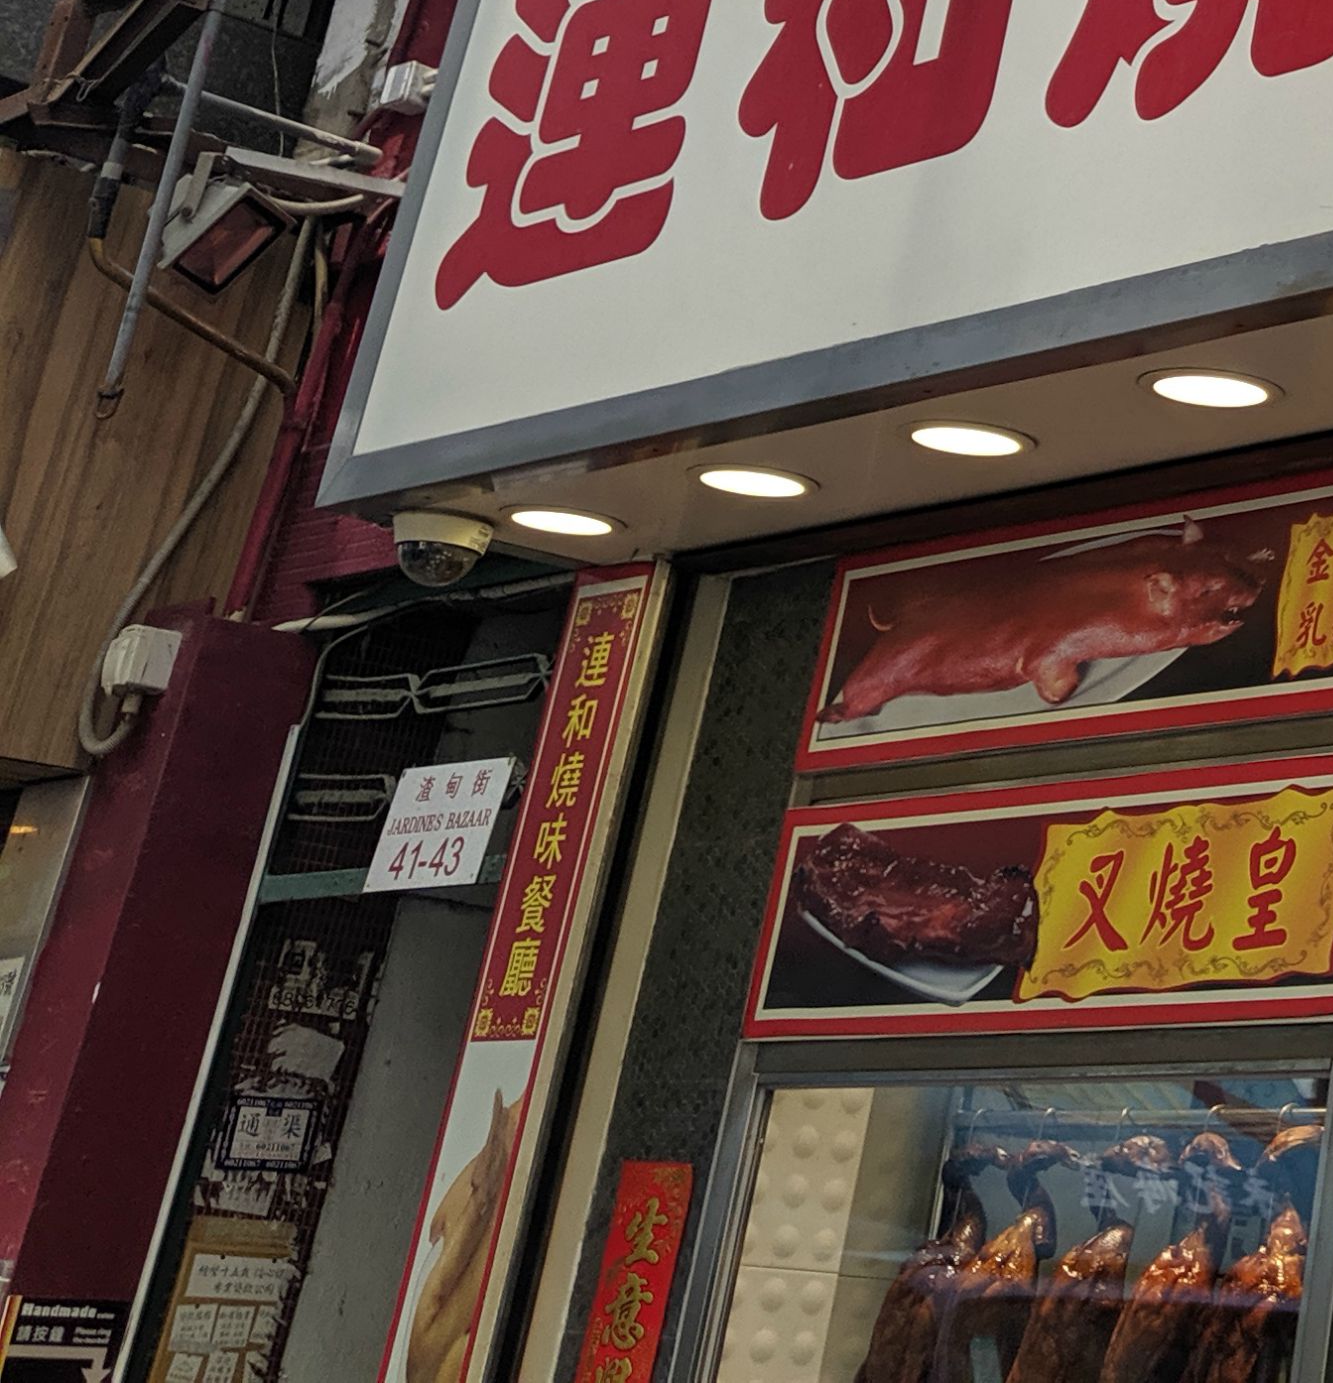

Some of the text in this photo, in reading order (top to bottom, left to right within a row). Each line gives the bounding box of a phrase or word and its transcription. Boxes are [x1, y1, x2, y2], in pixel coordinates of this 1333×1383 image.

[415, 768, 493, 803] 渣甸街
[445, 808, 492, 831] BAZAAR
[499, 630, 615, 998] 連和燒味餐廳
[387, 836, 465, 881] 41-43
[1062, 826, 1297, 952] 叉燒皇
[20, 1302, 97, 1319] Handmade
